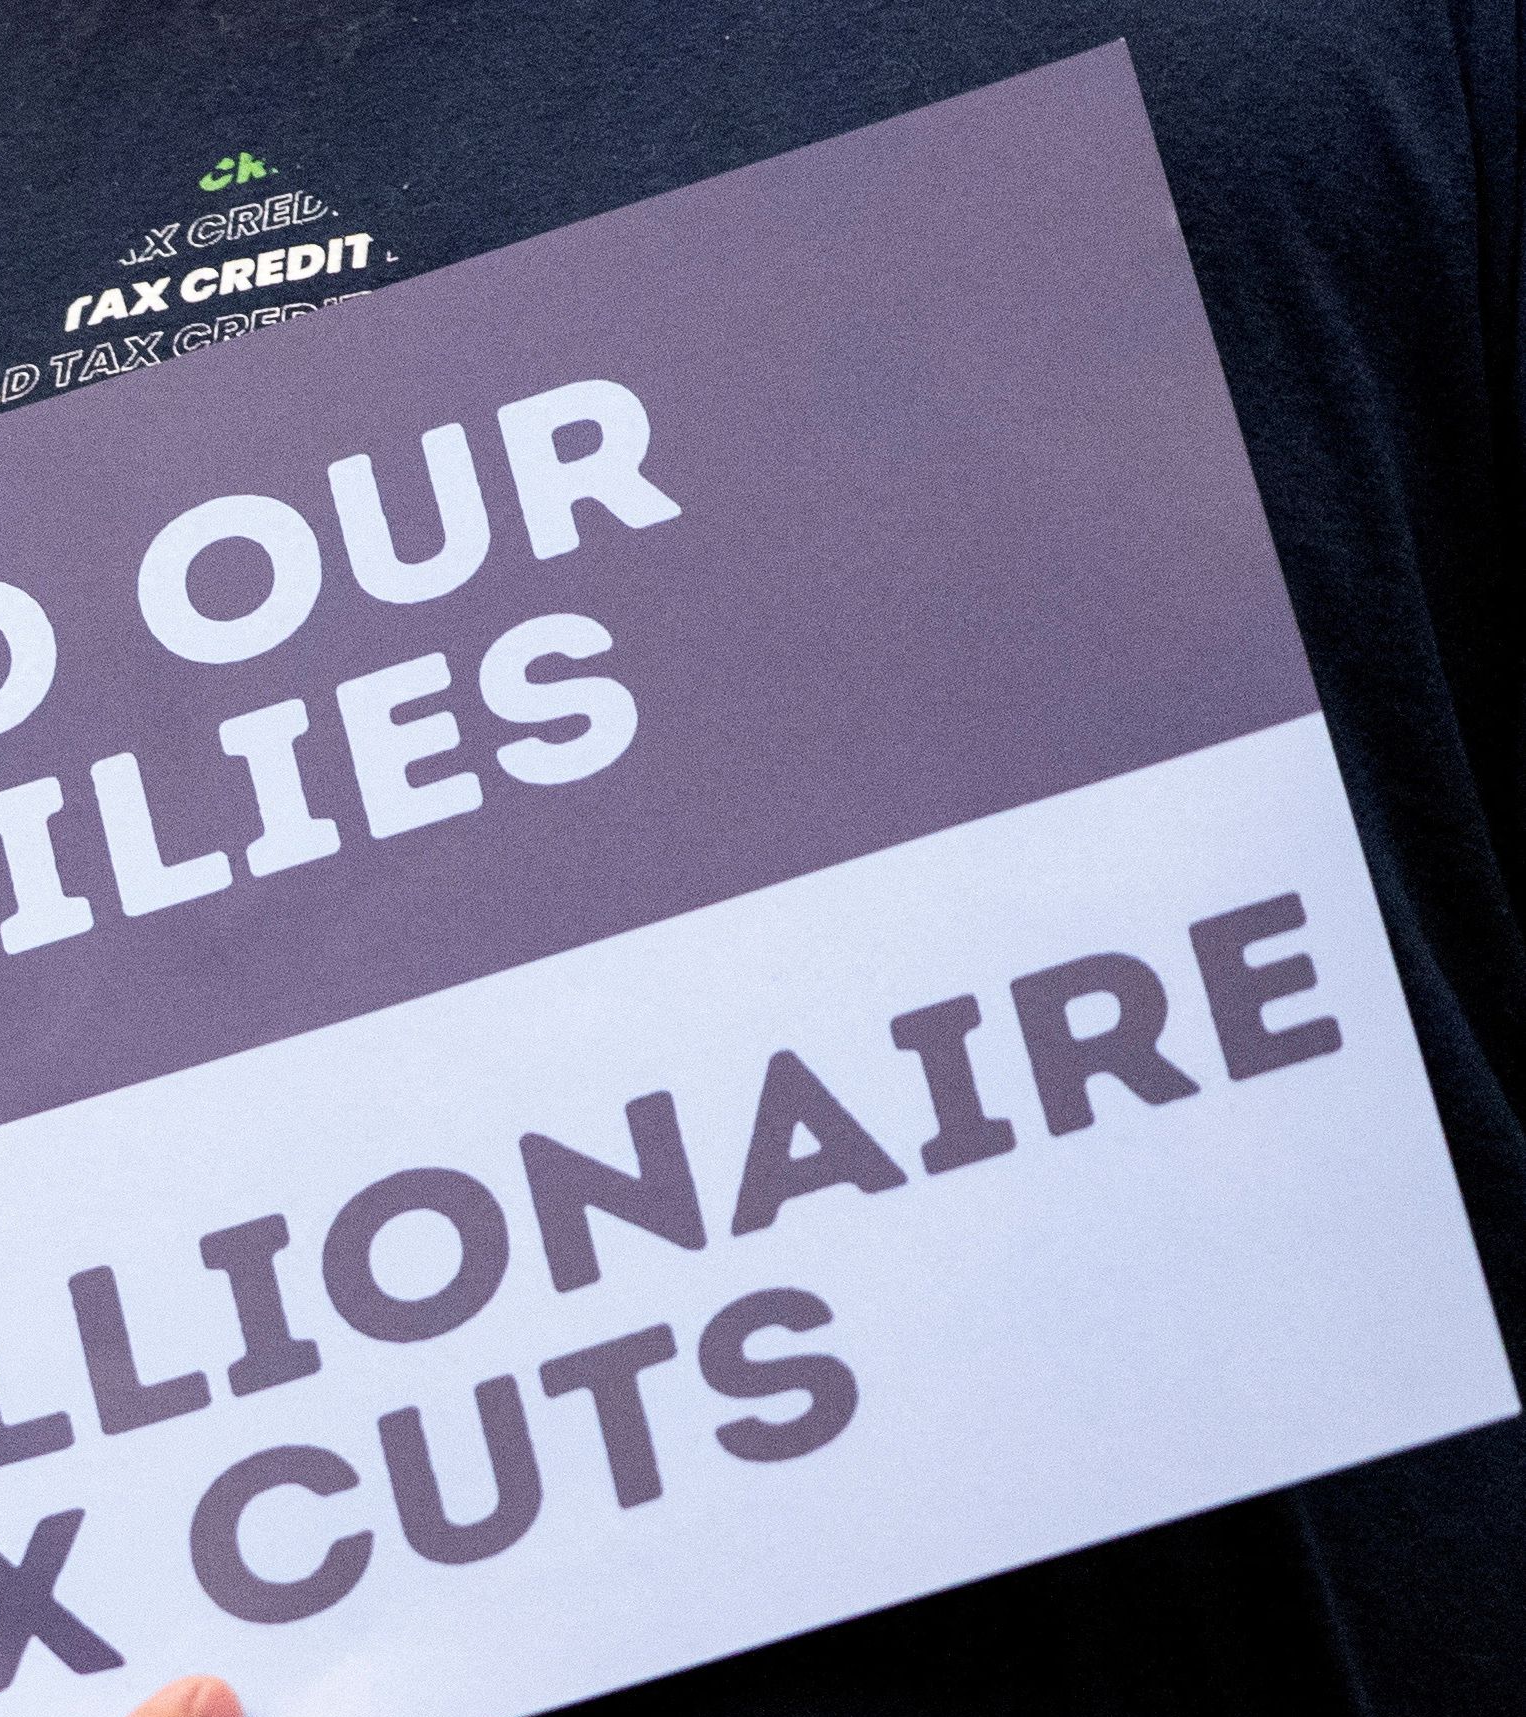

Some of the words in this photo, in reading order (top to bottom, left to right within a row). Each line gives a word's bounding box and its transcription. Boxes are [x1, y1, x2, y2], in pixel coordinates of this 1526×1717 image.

[180, 232, 375, 305] CREDIT
[50, 331, 164, 388] TAX
[138, 379, 681, 664] OUR
[190, 1288, 859, 1624] CUTS
